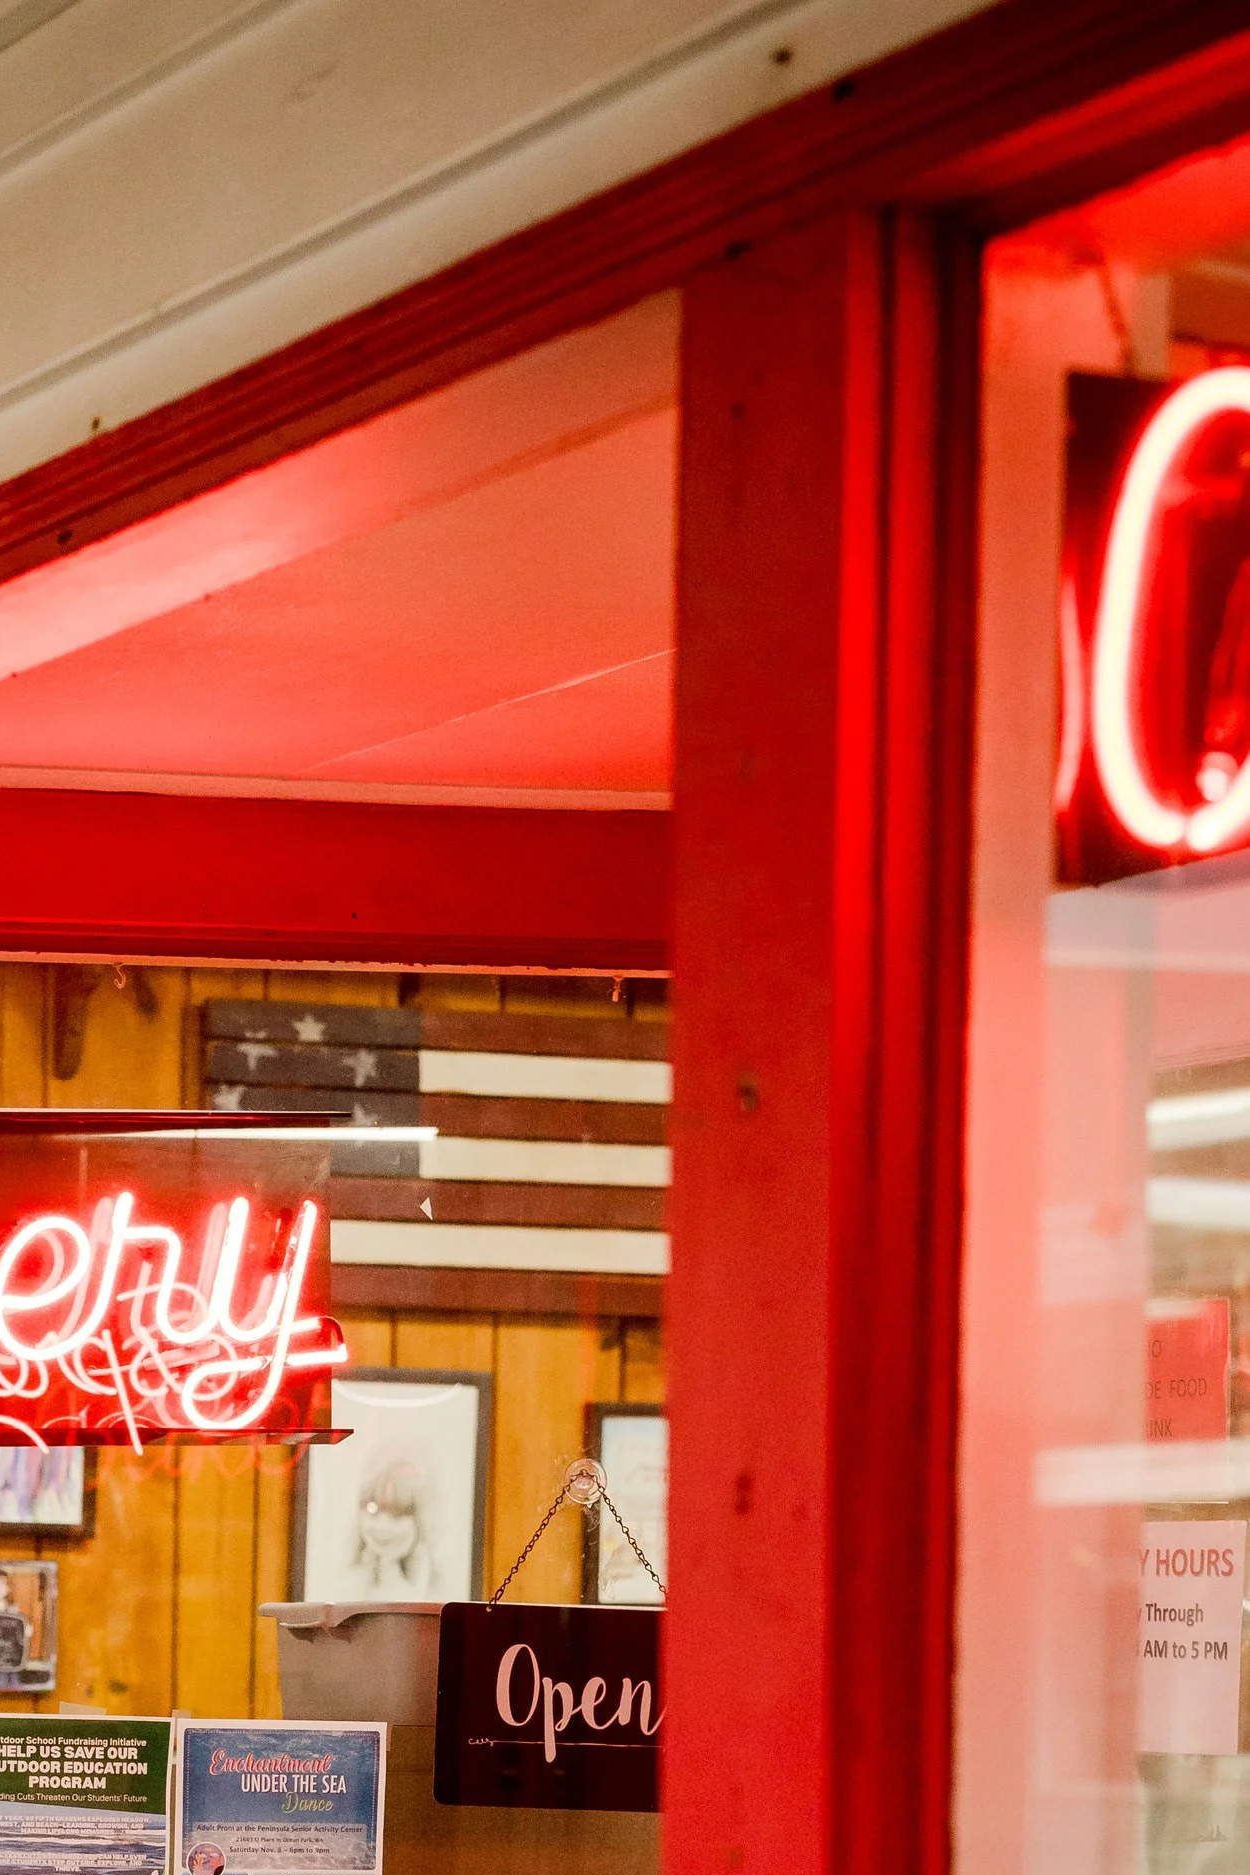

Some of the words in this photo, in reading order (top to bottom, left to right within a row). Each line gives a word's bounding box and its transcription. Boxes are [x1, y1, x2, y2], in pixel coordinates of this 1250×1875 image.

[1170, 1378, 1207, 1398] FOOD
[1155, 1548, 1234, 1578] HOURS
[1145, 1602, 1204, 1627] Through
[1144, 1640, 1168, 1659] AM
[1172, 1642, 1187, 1659] to
[1191, 1641, 1199, 1659] 5
[1204, 1641, 1228, 1660] PM
[496, 1643, 666, 1763] Open
[26, 1736, 56, 1745] School
[58, 1737, 108, 1747] Fundraising
[110, 1738, 147, 1747] Initiative
[40, 1745, 61, 1758] US
[64, 1746, 105, 1759] SAVE
[107, 1747, 138, 1760] OUR
[209, 1747, 335, 1775] Enchantment
[63, 1761, 148, 1775] EDUCATION
[28, 1775, 107, 1789] PROGRAM
[241, 1773, 288, 1793] UNDER
[292, 1774, 317, 1793] THE
[322, 1775, 347, 1794] SEA
[17, 1793, 35, 1801] Cuts
[36, 1793, 71, 1801] Threaten
[71, 1793, 86, 1801] Our
[123, 1794, 147, 1802] Future
[281, 1791, 334, 1814] Dance
[196, 1824, 215, 1832] Adult
[257, 1825, 290, 1833] Peninsula
[291, 1825, 312, 1833] Senior
[313, 1825, 339, 1834] Activity
[229, 1846, 259, 1855] Saturday
[260, 1846, 276, 1854] Nov.
[289, 1847, 304, 1855] 6pm
[314, 1847, 330, 1855] 9pm
